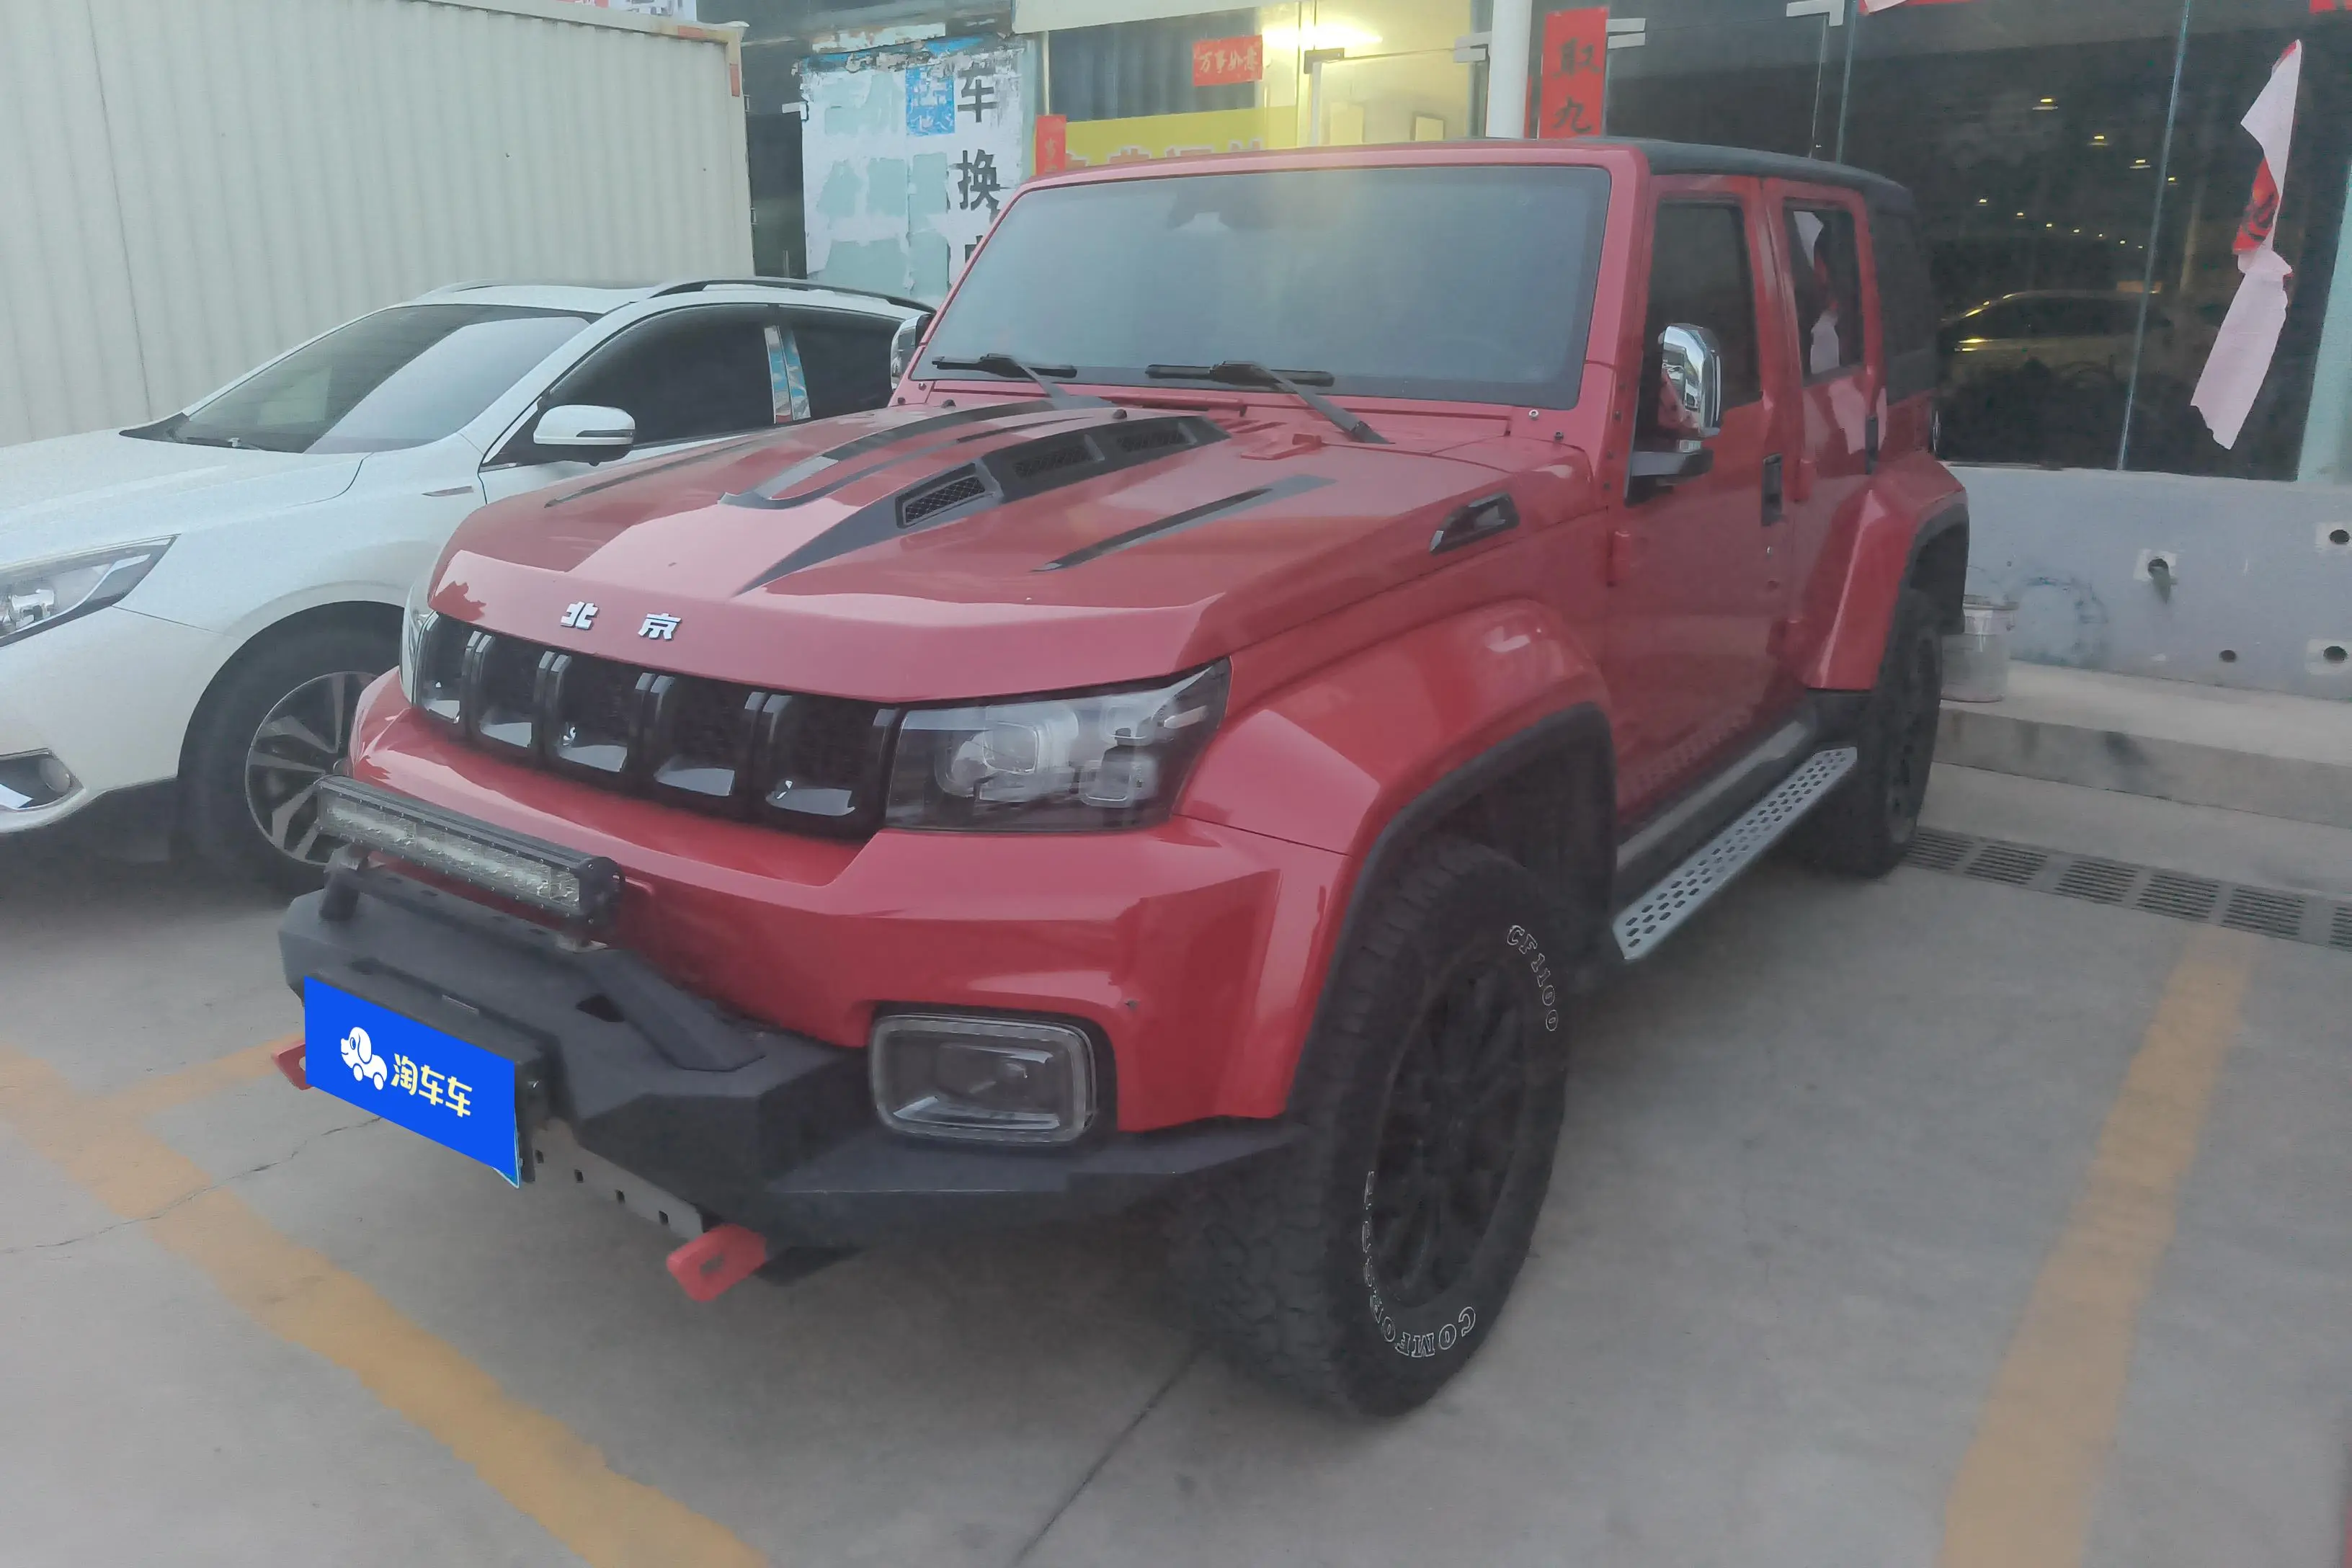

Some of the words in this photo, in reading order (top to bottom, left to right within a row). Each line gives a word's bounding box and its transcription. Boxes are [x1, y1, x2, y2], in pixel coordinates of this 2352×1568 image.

[957, 61, 1002, 264] 车换
[560, 602, 682, 641] 北京
[1507, 925, 1559, 1032] CF1100
